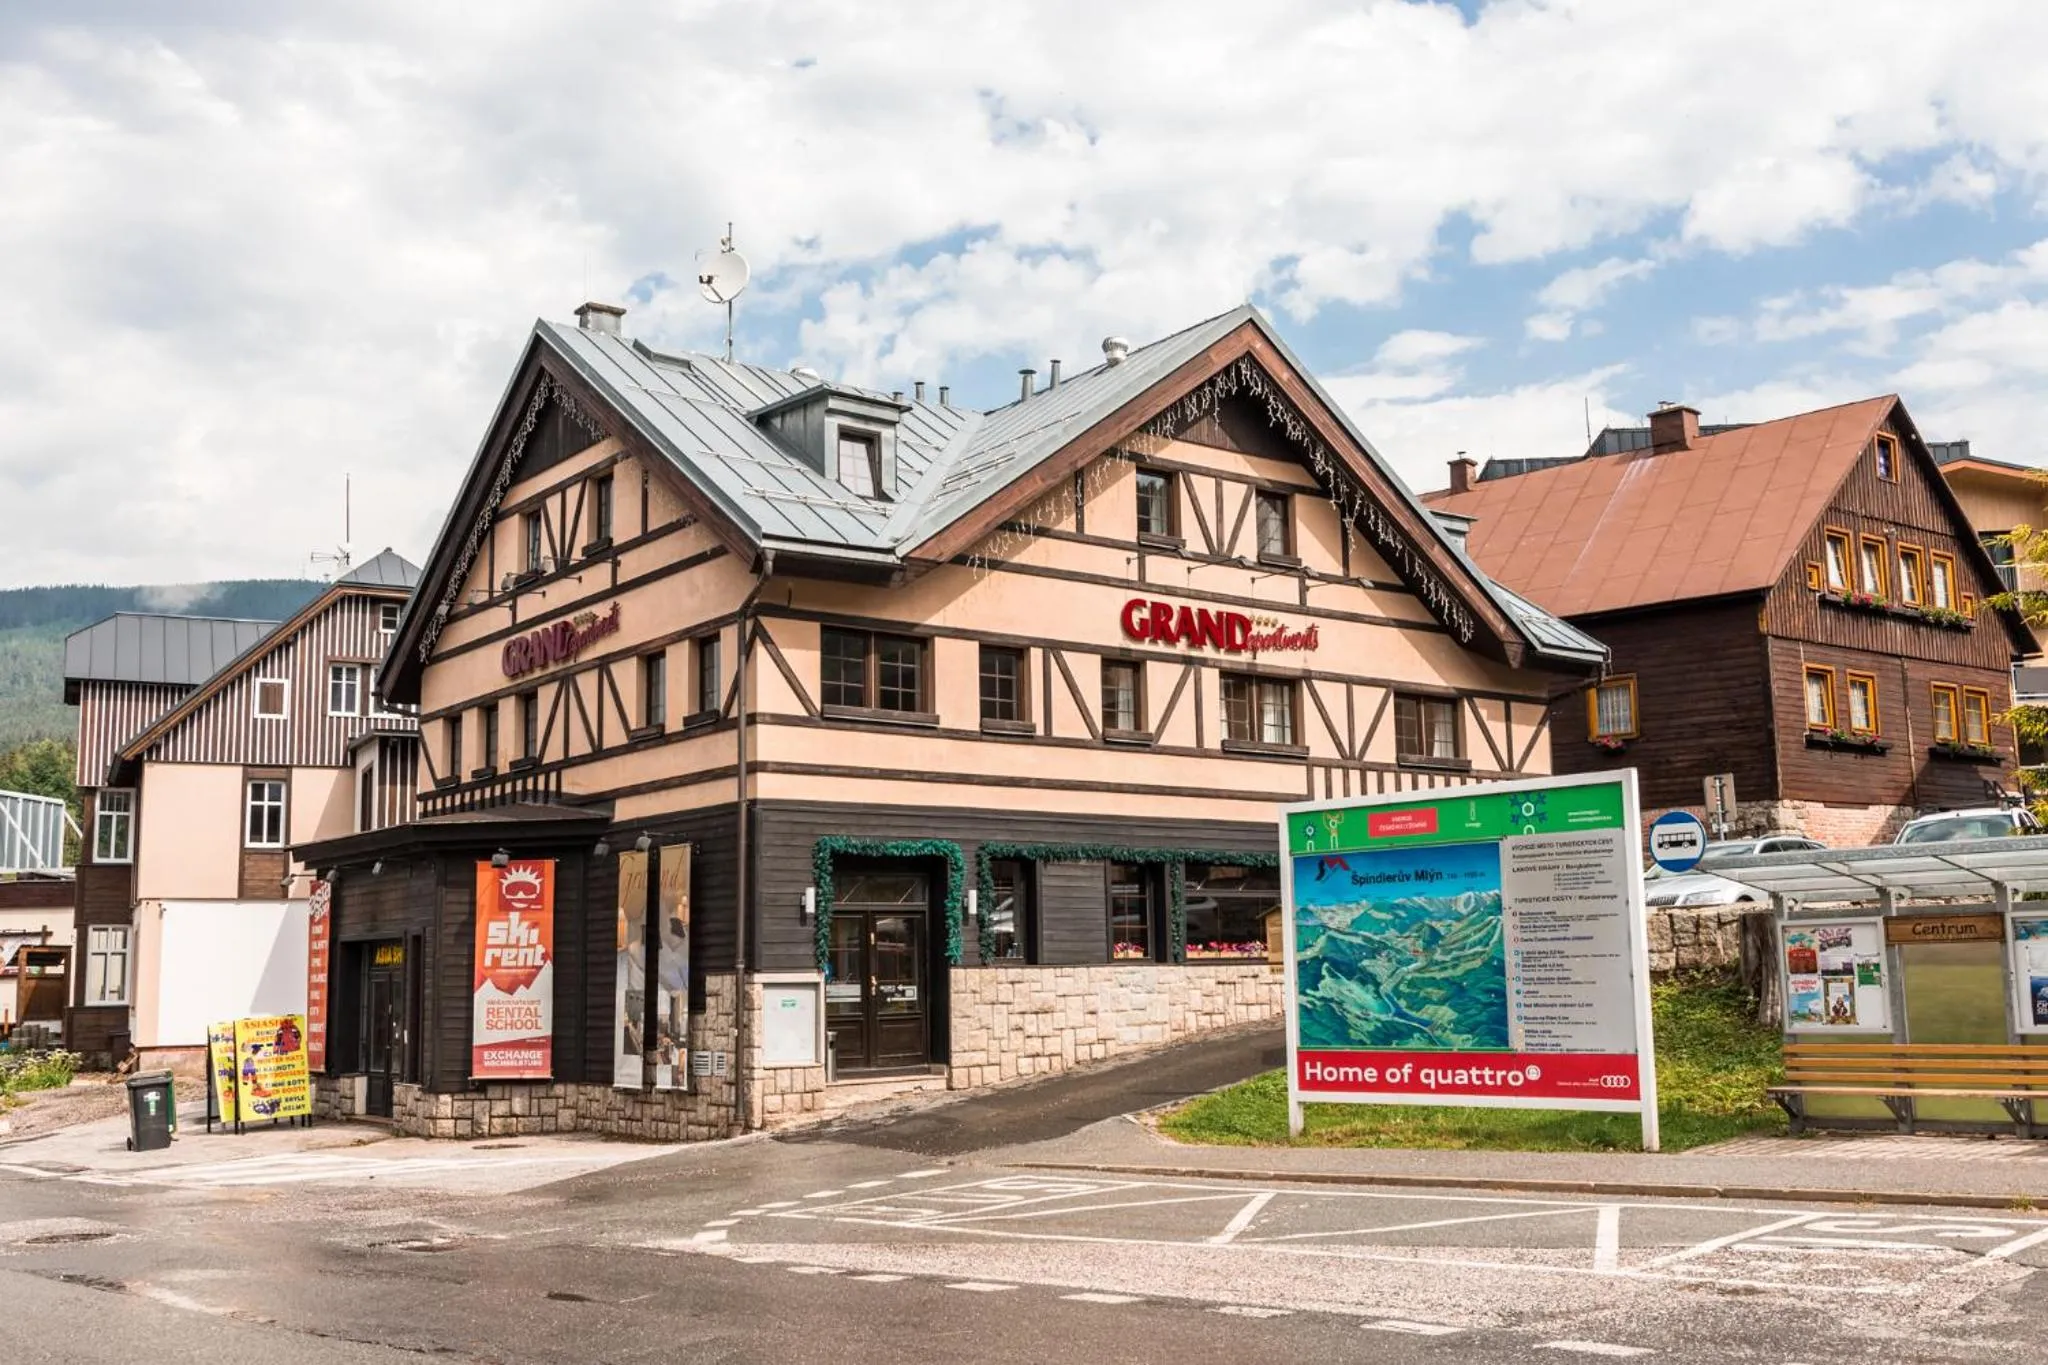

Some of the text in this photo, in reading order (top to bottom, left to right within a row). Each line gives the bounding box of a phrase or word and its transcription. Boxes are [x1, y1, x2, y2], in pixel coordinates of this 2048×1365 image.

[1121, 598, 1251, 652] GRAND
[502, 620, 576, 679] GRAND
[1351, 869, 1411, 887] Špindlerův
[1415, 868, 1443, 883] Mlýn
[486, 911, 540, 946] ski
[1911, 922, 1978, 937] Centrum
[484, 944, 546, 968] rent
[486, 1006, 542, 1018] RENTAL
[486, 1018, 543, 1030] SCHOOL
[484, 1050, 543, 1060] EXCHANGE
[1304, 1061, 1377, 1083] Home
[1385, 1063, 1413, 1083] of
